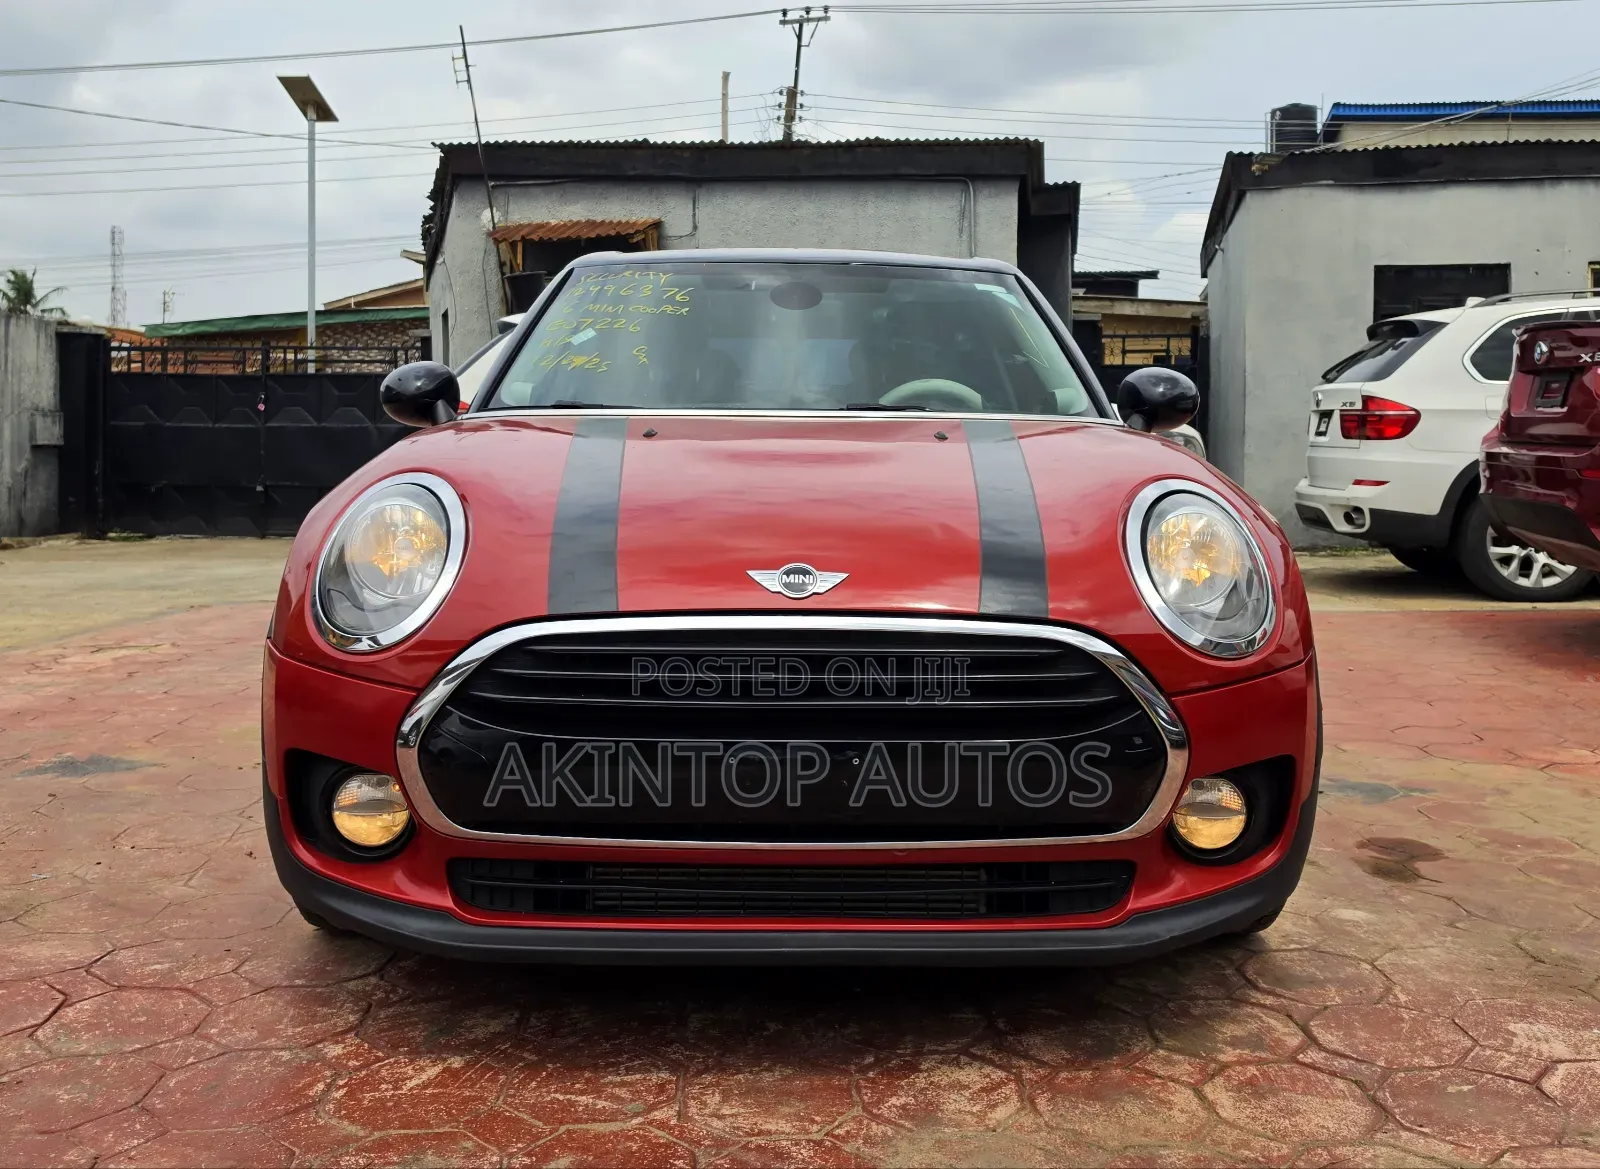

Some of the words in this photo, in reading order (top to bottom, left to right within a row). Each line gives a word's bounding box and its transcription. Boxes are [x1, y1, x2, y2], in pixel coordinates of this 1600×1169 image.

[575, 270, 674, 287] SECURITY
[628, 304, 690, 316] COOPER
[781, 573, 814, 584] MINI
